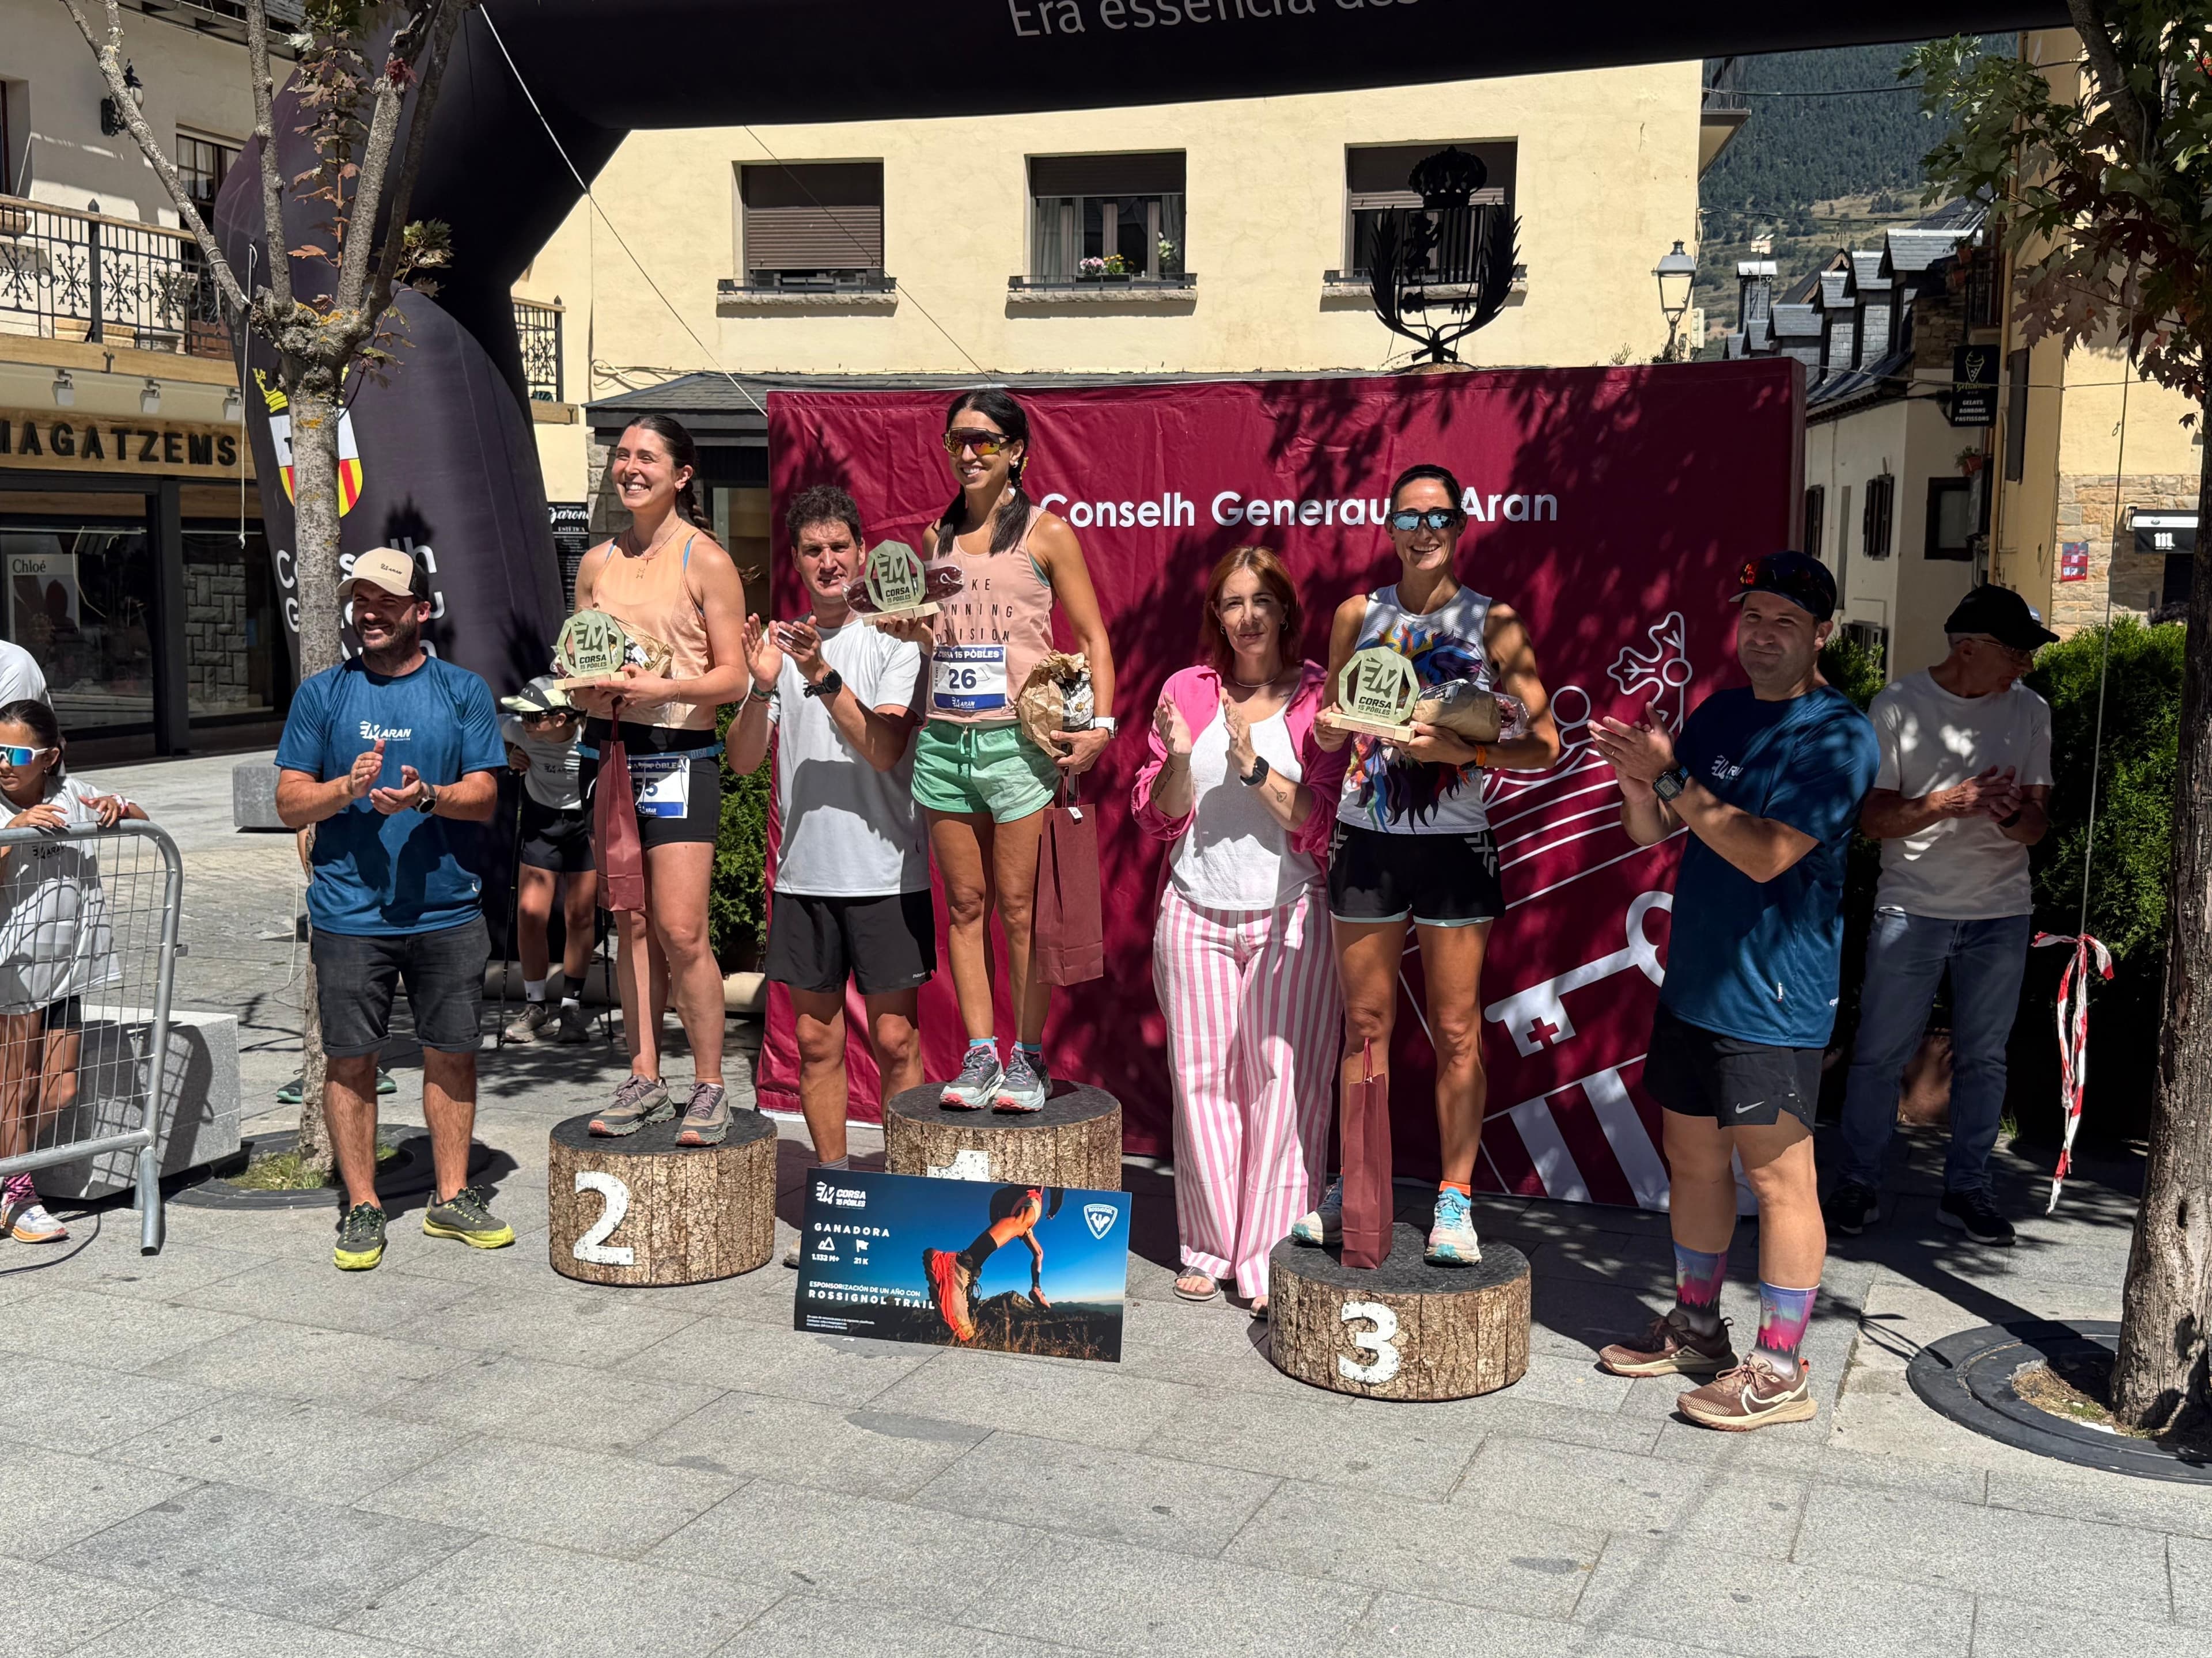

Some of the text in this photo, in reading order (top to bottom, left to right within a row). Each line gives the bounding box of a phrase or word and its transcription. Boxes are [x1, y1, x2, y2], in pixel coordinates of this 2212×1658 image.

[1009, 0, 1085, 37] Era
[1040, 492, 1195, 528] Conselh
[1211, 491, 1391, 526] Generau
[12, 559, 46, 574] Chloé
[885, 586, 911, 597] CORSA
[579, 654, 607, 664] CORSA
[964, 649, 1000, 659] PÒBLES
[948, 668, 977, 689] 26
[1358, 696, 1392, 709] CORSA
[380, 729, 412, 738] ARAN
[836, 1189, 866, 1199] CORSA
[573, 1171, 634, 1266] 2
[814, 1222, 890, 1237] GANADORA
[853, 1257, 862, 1265] 21
[809, 1281, 869, 1292] ESPONSORIZACIÓN
[890, 1288, 905, 1296] AÑO
[808, 1289, 935, 1310] ROSSIGNOL TRAIL
[1339, 1301, 1400, 1384] 3
